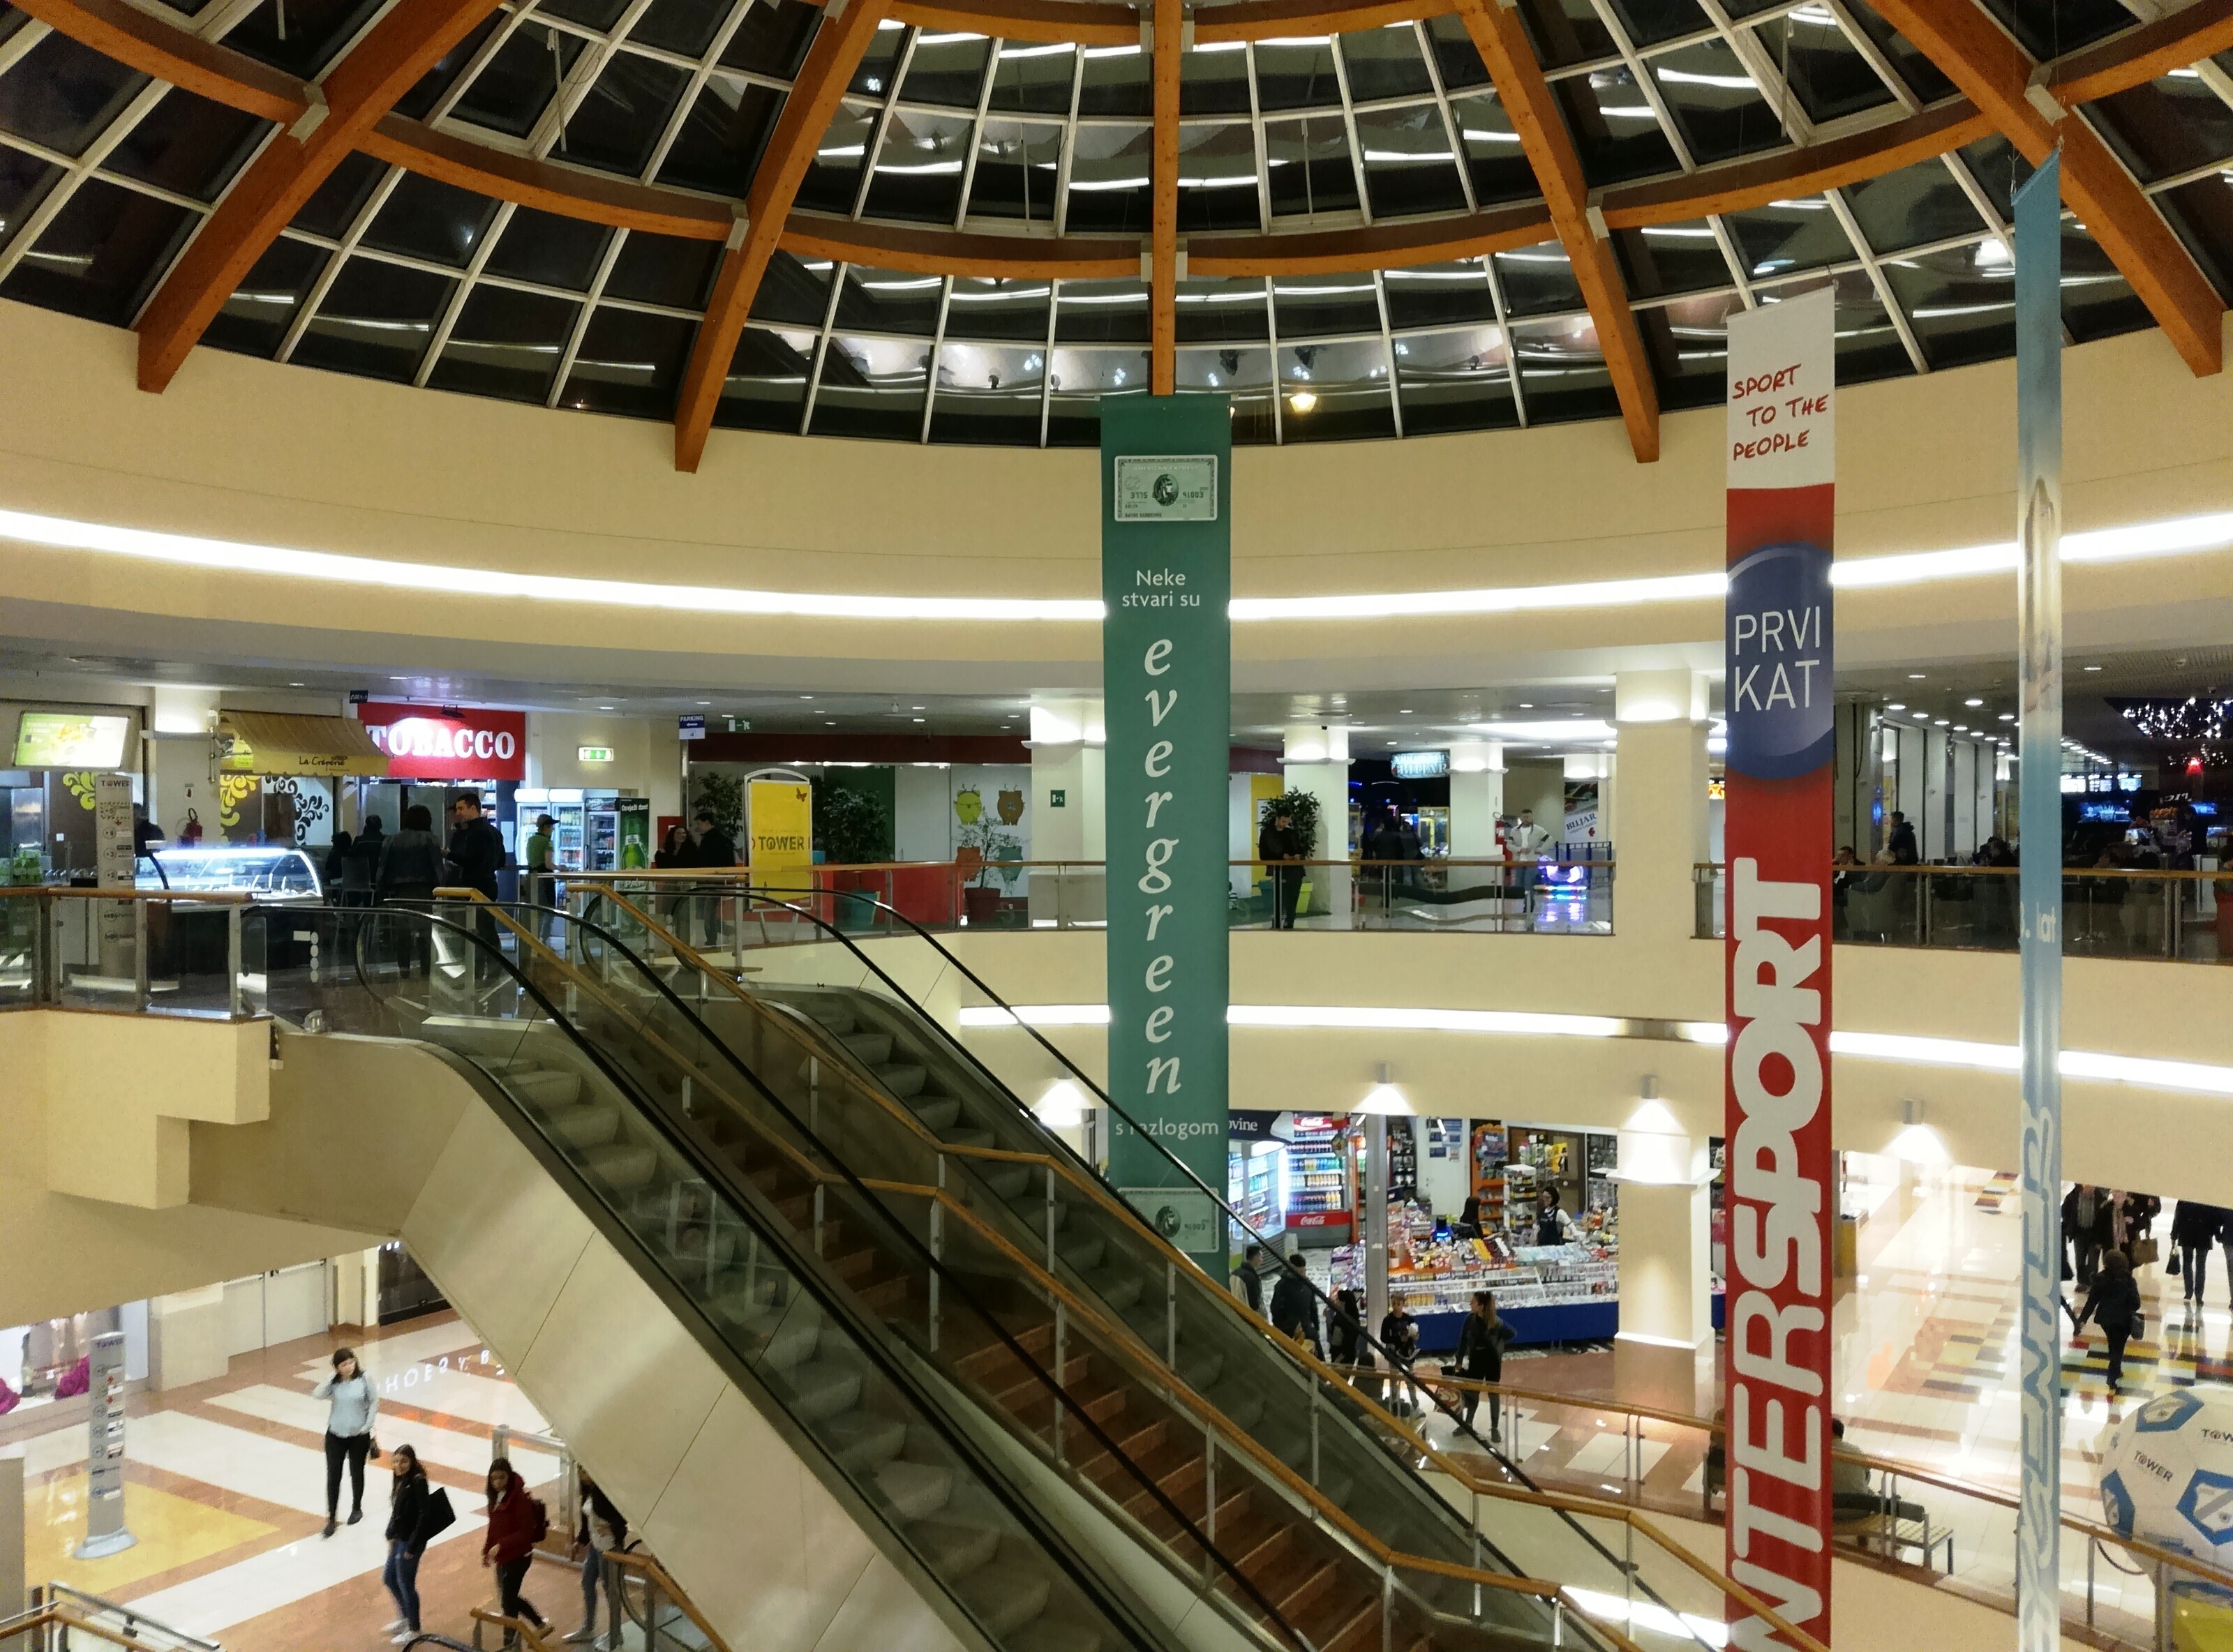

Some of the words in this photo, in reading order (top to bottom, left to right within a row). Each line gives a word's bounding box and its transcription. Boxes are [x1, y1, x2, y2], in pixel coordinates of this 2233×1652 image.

[1732, 363, 1802, 399] SPORT
[1746, 405, 1777, 427] TO
[1785, 393, 1829, 418] THE
[1733, 429, 1810, 461] PEOPLE
[1136, 568, 1186, 586] Neke
[1122, 590, 1173, 607] stvari
[1180, 594, 1200, 606] su
[1735, 606, 1821, 656] PRVI
[1735, 659, 1820, 712] KAT
[366, 723, 515, 760] TOBACCO
[299, 756, 309, 765] La
[1566, 813, 1597, 830] BILJAR
[758, 836, 804, 850] TOWER
[1138, 638, 1182, 1095] evergreen
[1115, 1122, 1123, 1136] s
[2134, 1450, 2174, 1482] TOWER
